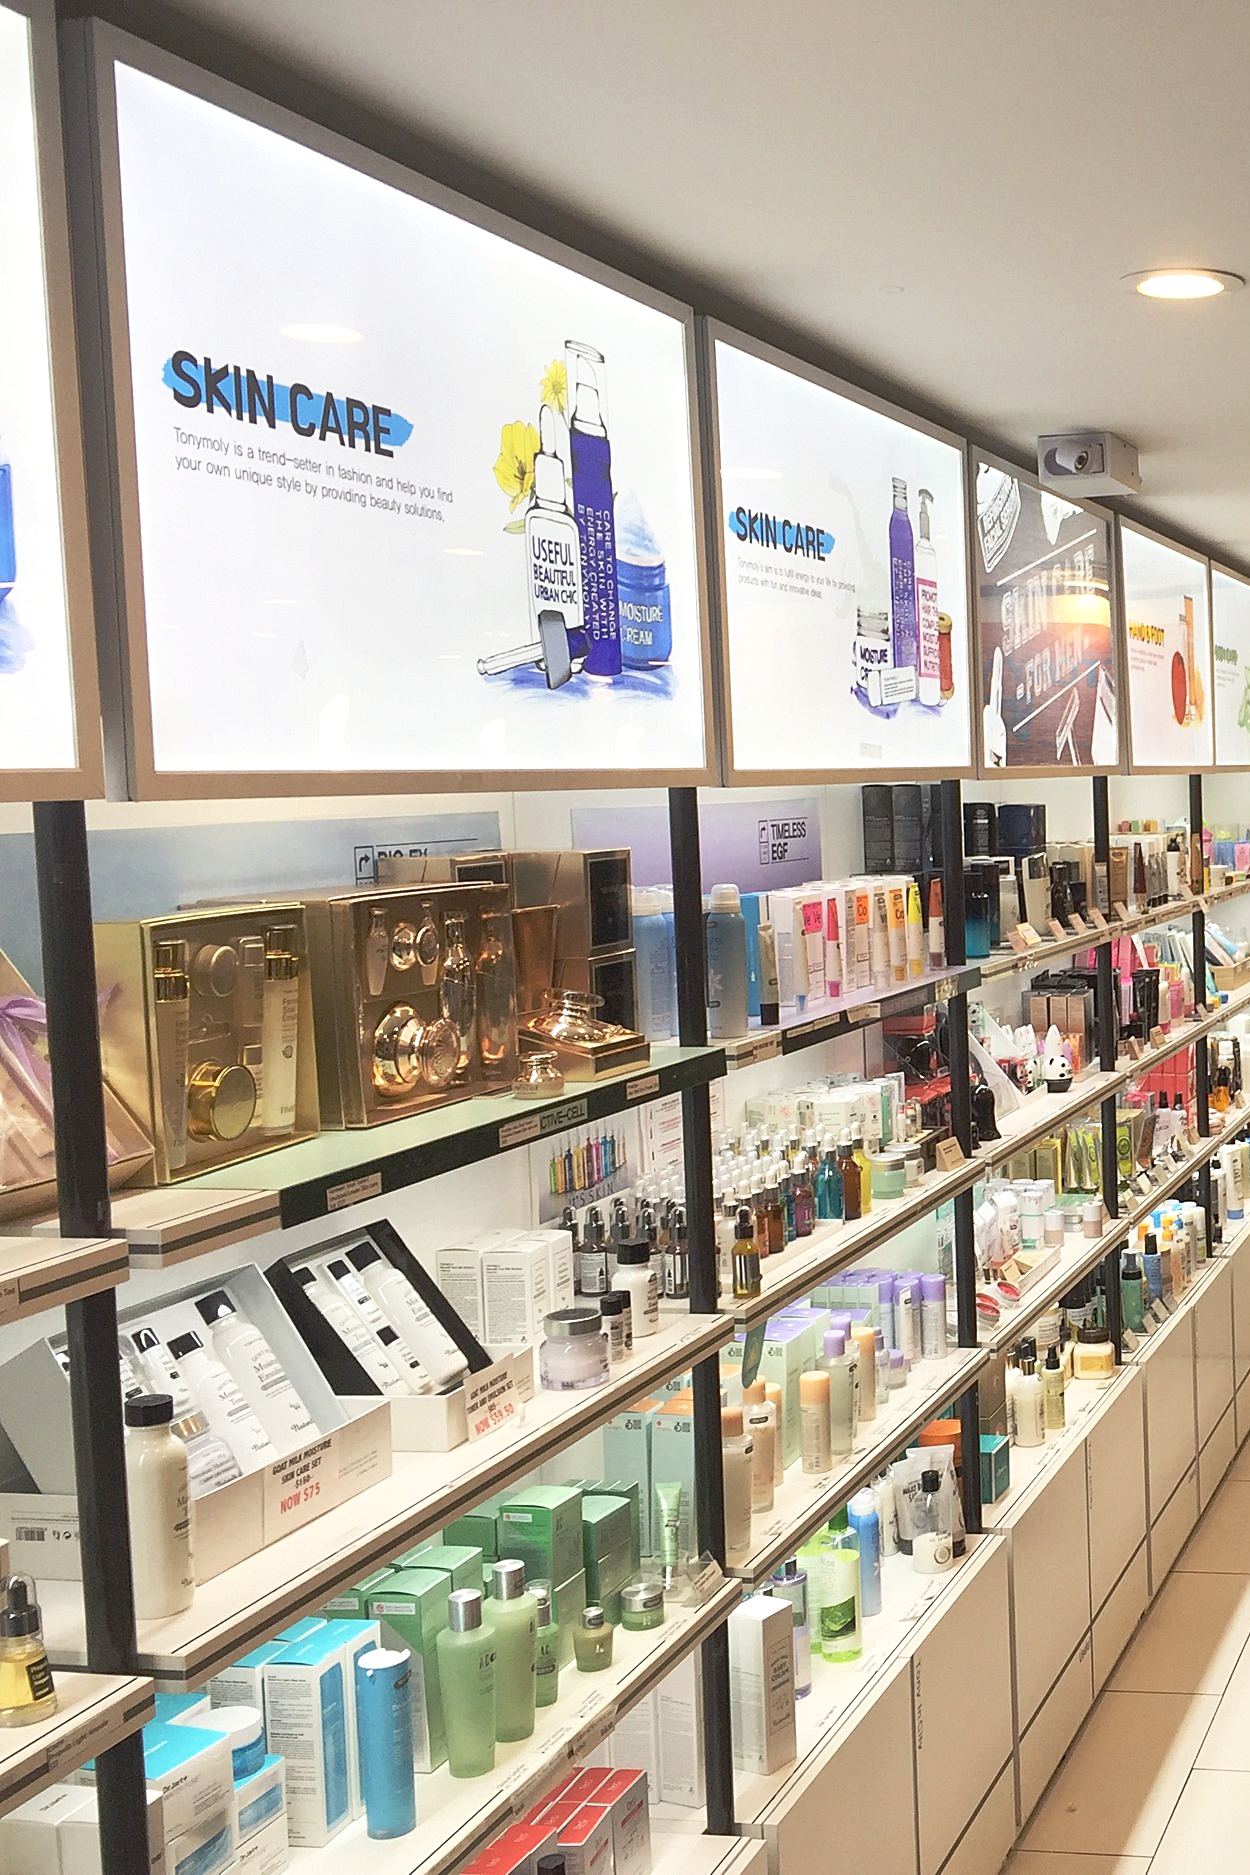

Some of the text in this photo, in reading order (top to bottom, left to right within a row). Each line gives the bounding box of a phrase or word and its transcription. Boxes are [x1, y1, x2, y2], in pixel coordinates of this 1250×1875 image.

[172, 350, 394, 459] SKIN CARE
[173, 426, 453, 503] Tonymoly is a trend-setter in fashion and help you find
[175, 455, 445, 522] your own unique style by providing beauty solutions.
[595, 509, 603, 541] THE
[735, 506, 826, 562] SKIN CARE
[532, 535, 574, 567] USEFUL
[534, 563, 576, 587] BEAUTIFUL
[586, 507, 600, 640] ENERGY CREATED
[597, 550, 605, 589] SKIN
[603, 510, 617, 640] CARE TO CHANGE
[534, 583, 578, 605] URBAN CHIC
[619, 600, 664, 623] MOISTURE
[860, 645, 889, 664] MOISTURE
[770, 821, 807, 840] TIMELESS
[771, 842, 788, 860] EGF
[272, 1438, 332, 1475] GOAT MILK MOISTURE
[281, 1456, 322, 1484] SKIN CARE SET
[280, 1481, 320, 1513] NOW $75
